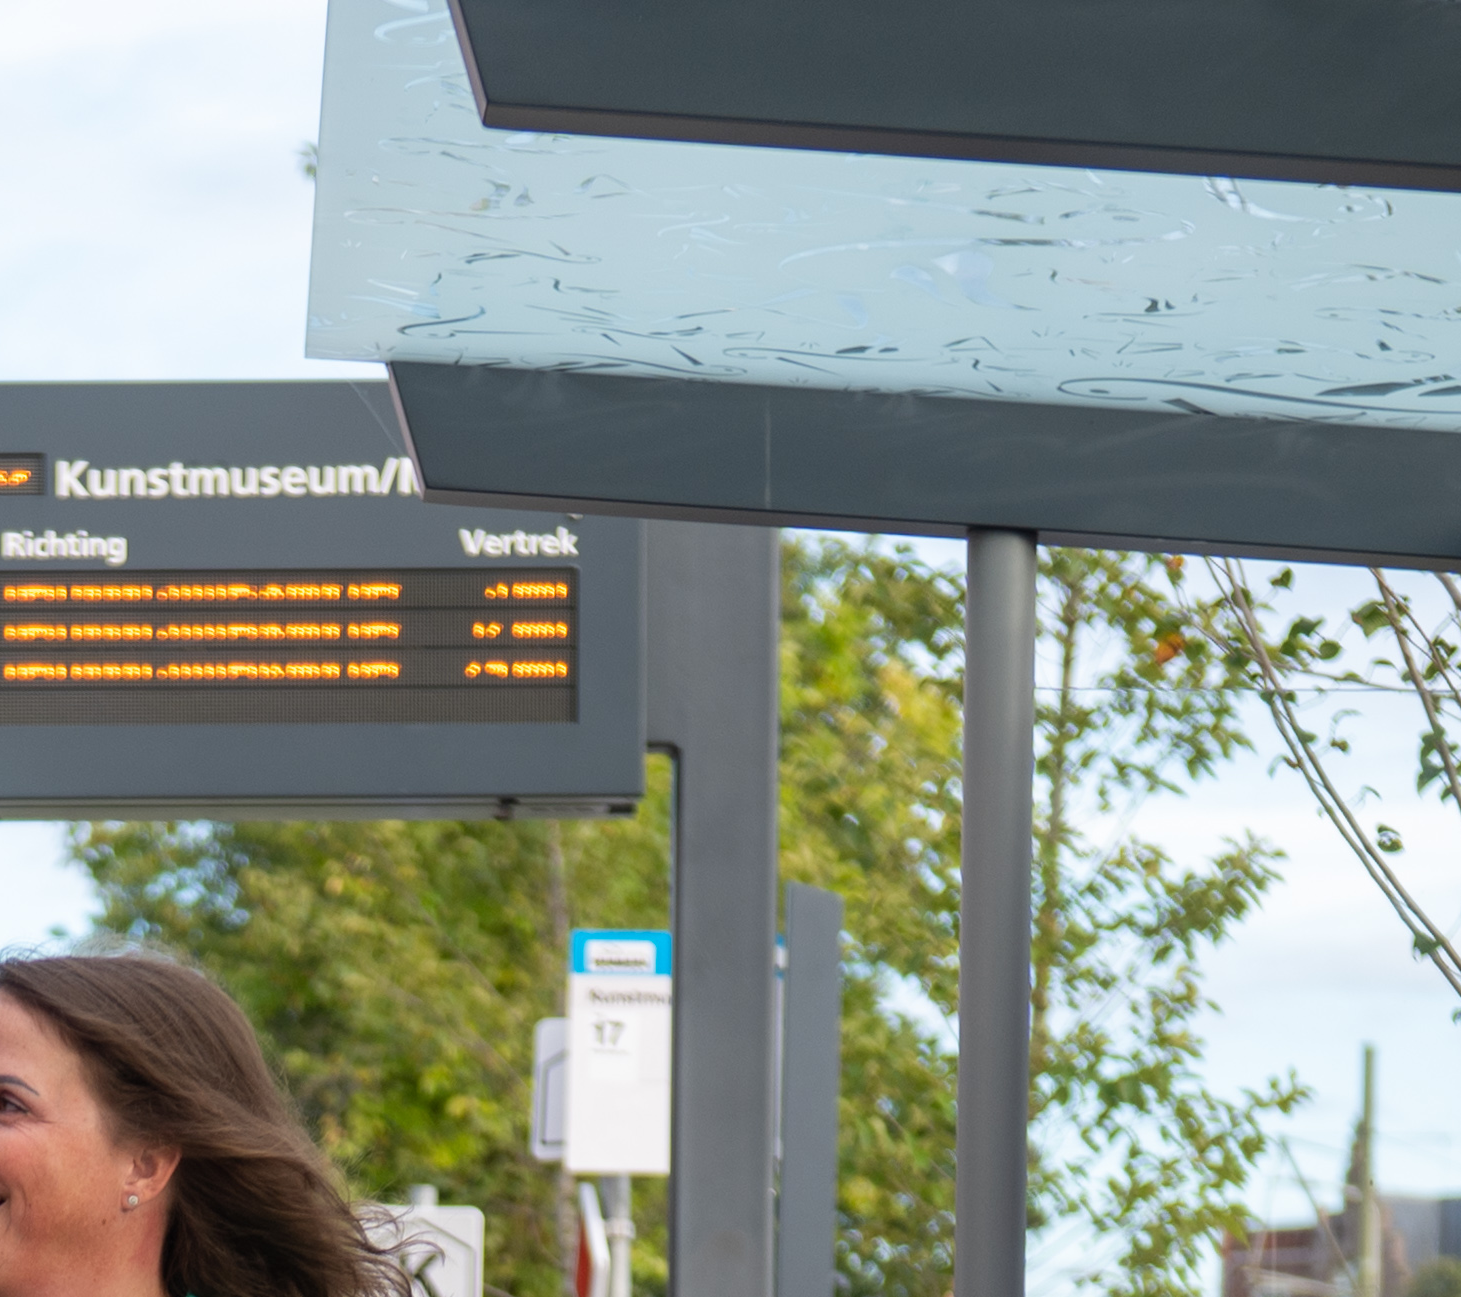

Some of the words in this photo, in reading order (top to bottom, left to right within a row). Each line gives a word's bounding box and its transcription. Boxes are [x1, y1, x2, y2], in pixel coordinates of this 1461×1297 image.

[1, 529, 128, 566] Richting
[458, 525, 579, 558] Vertrek
[591, 1018, 627, 1047] 17
